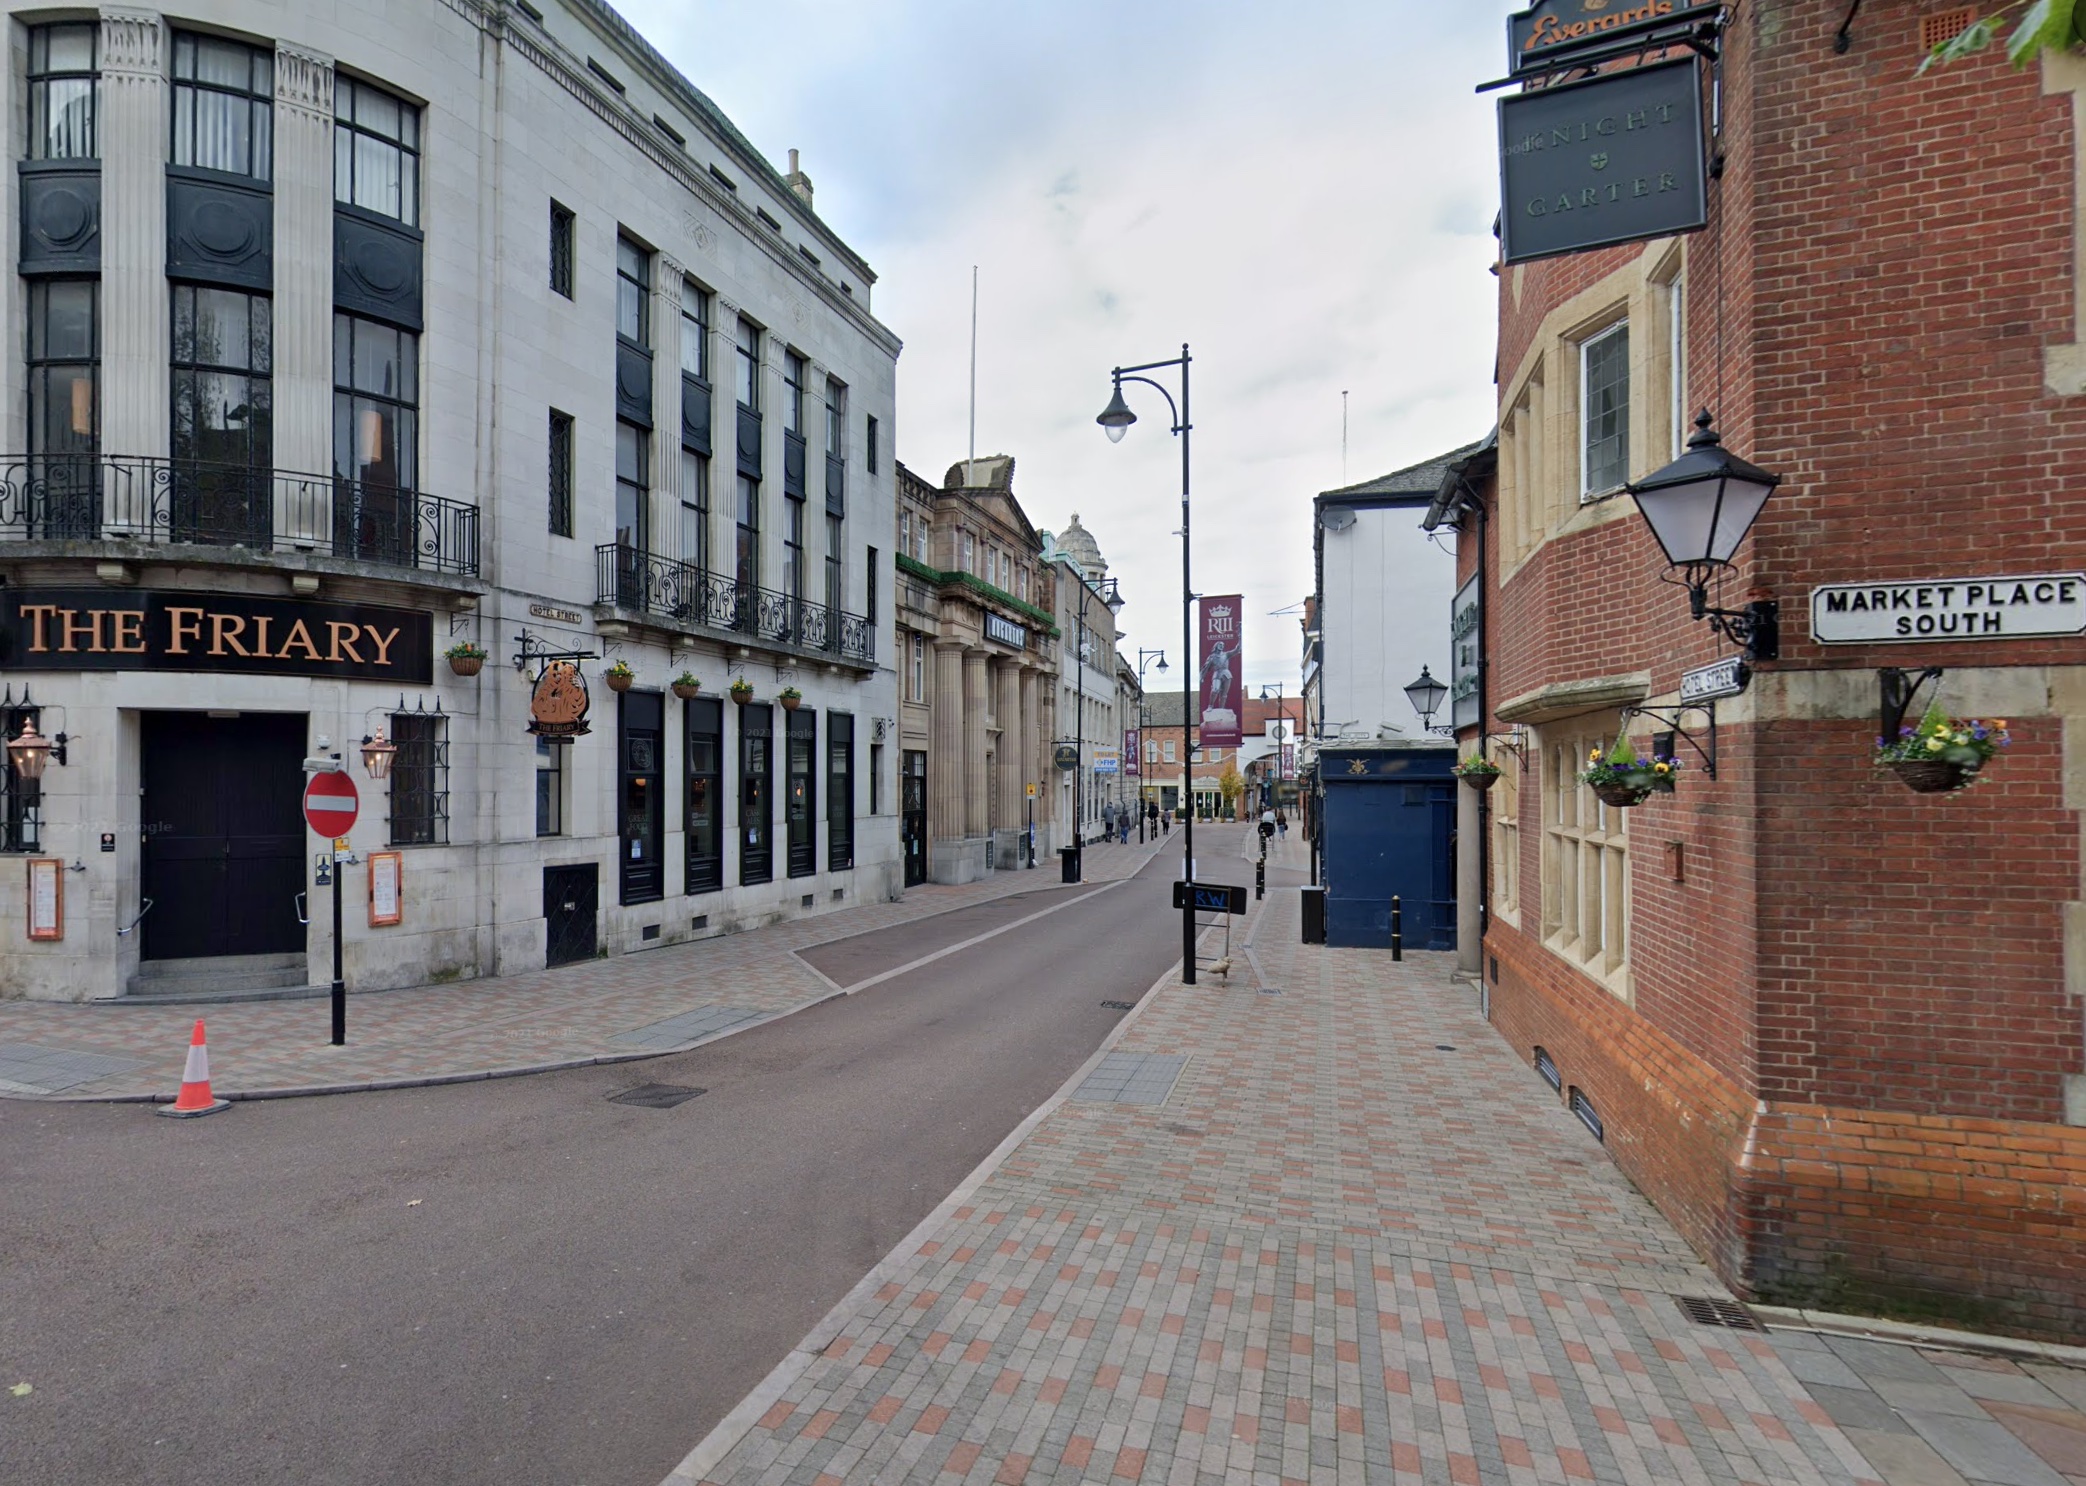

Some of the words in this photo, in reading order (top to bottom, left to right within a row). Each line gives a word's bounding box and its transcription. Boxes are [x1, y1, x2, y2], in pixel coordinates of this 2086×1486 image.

[1524, 0, 1674, 51] Everards
[1526, 103, 1676, 154] KNIGHT
[1527, 172, 1680, 219] GARTER
[1826, 587, 1955, 612] MARKET
[1967, 581, 2077, 606] PLACE
[533, 606, 554, 617] HOTEL
[556, 610, 580, 622] STREET
[1896, 611, 2001, 635] SOUTH
[20, 604, 147, 653] THE
[164, 606, 401, 665] FRIARY
[1681, 675, 1704, 694] HOTEL
[1706, 665, 1736, 689] STREET
[539, 723, 551, 732] THE
[552, 724, 575, 732] FRIARY
